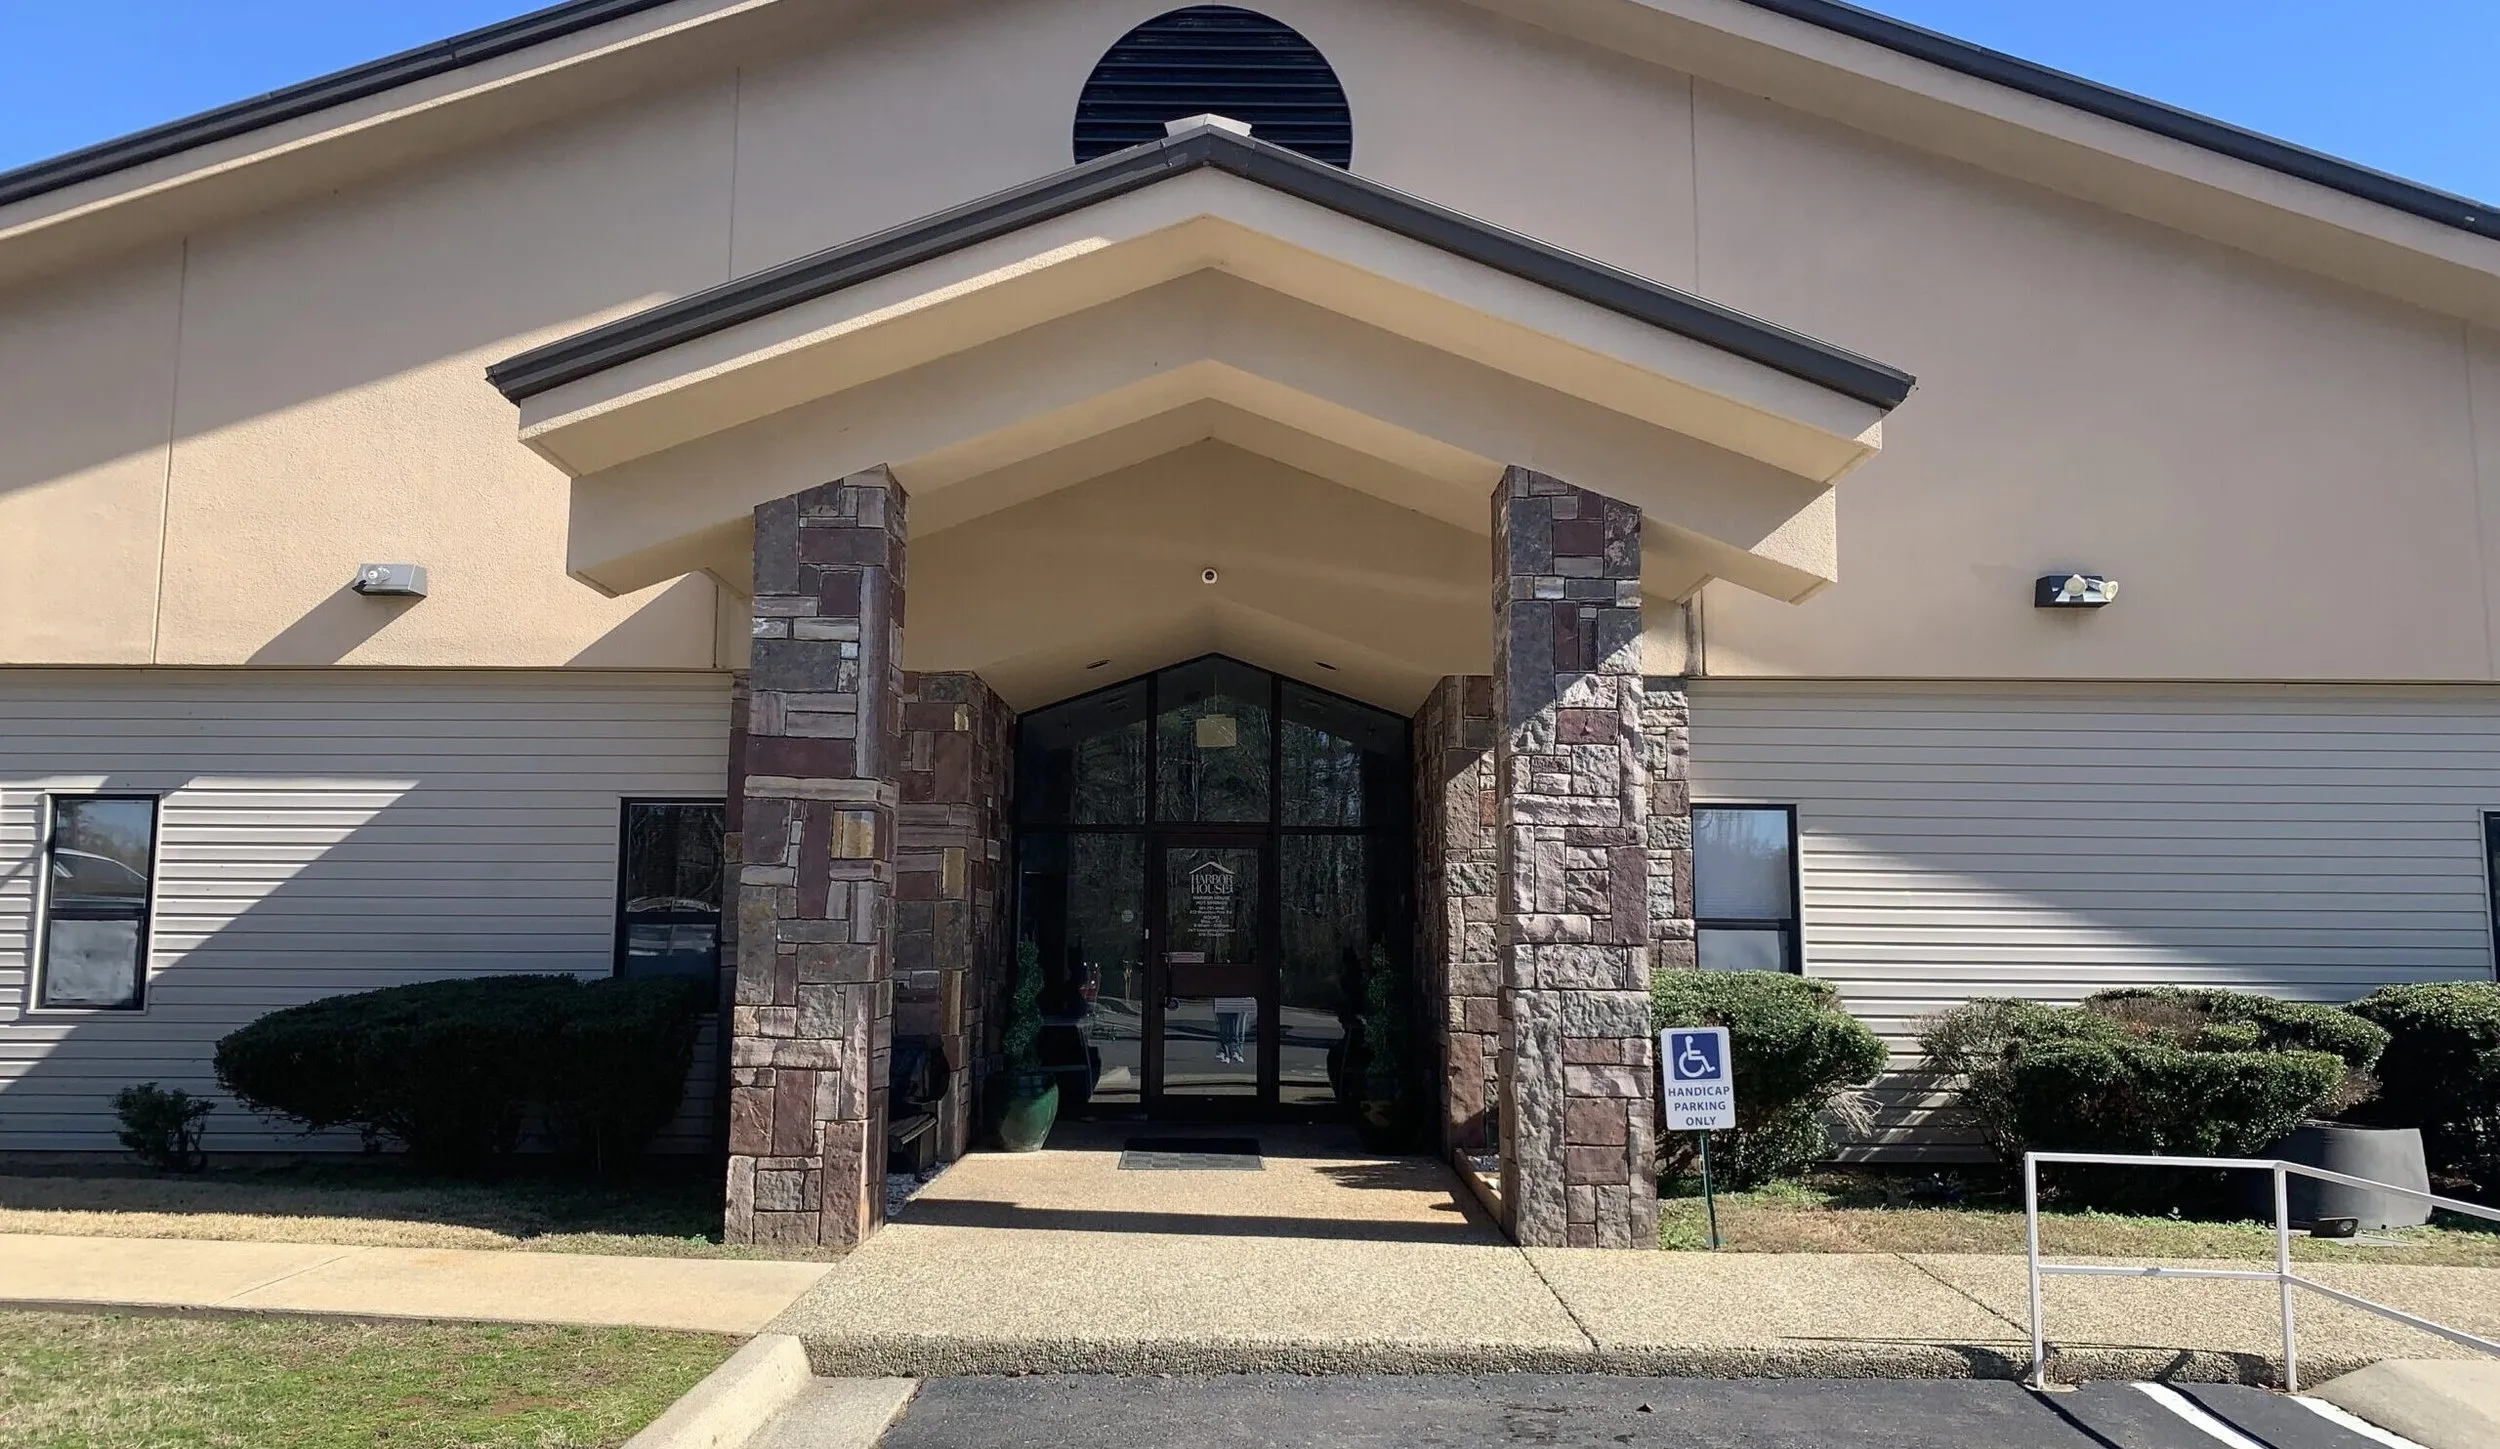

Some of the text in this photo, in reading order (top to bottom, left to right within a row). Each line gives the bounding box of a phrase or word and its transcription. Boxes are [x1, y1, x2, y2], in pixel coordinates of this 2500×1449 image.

[1191, 874, 1233, 884] HARBOR
[1191, 884, 1233, 894] HOUSE
[1668, 1086, 1730, 1096] HANDICAP
[1674, 1101, 1726, 1111] PARKING
[1686, 1117, 1716, 1126] ONLY
